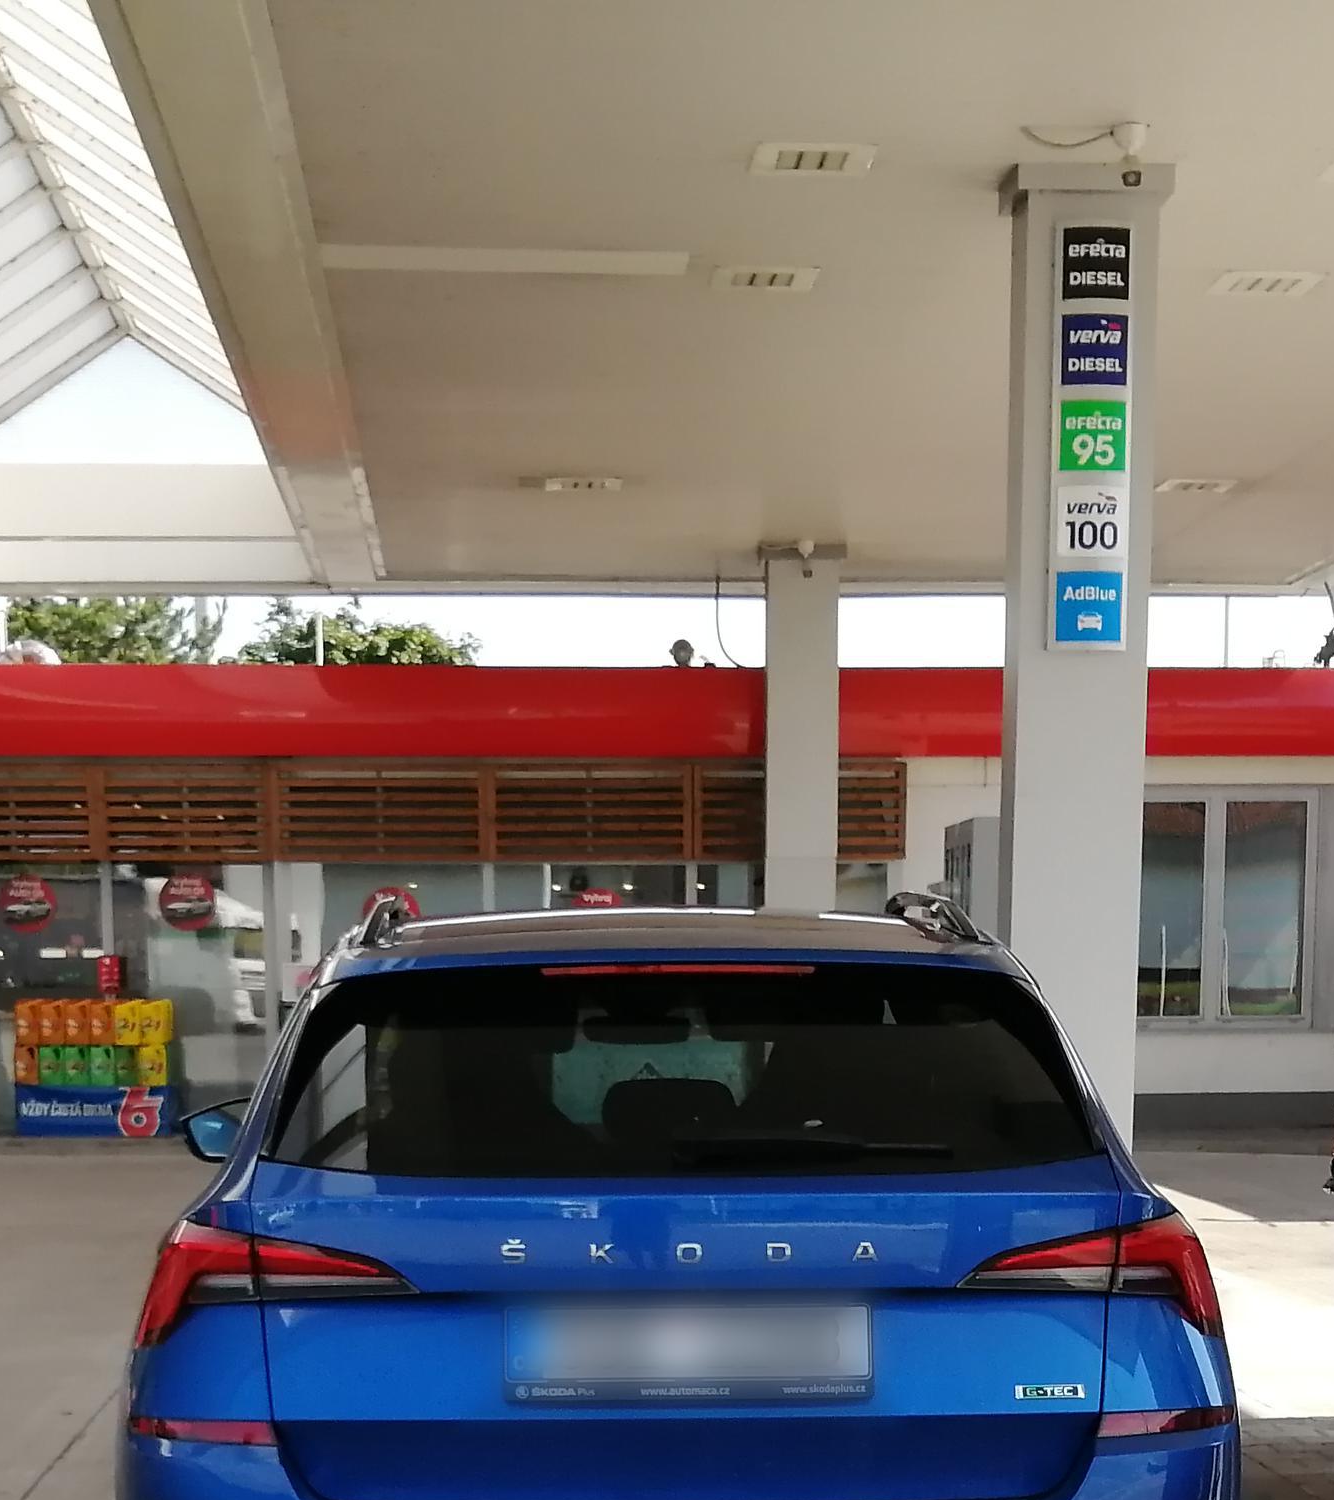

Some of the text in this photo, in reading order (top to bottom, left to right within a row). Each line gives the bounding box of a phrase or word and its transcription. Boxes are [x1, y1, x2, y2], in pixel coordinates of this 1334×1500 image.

[1068, 238, 1126, 258] efecta
[1069, 271, 1125, 286] DIESEL
[1069, 330, 1122, 344] verva
[1068, 357, 1123, 372] DIESEL
[1065, 416, 1122, 430] efecta
[1072, 433, 1115, 465] 95
[1067, 502, 1117, 515] verva
[1065, 520, 1118, 550] 100
[1063, 586, 1117, 601] AdBlue
[501, 1238, 878, 1264] ŠKODA
[531, 1385, 577, 1398] ŠKODA
[782, 1383, 867, 1396] www.skodaplus.cz
